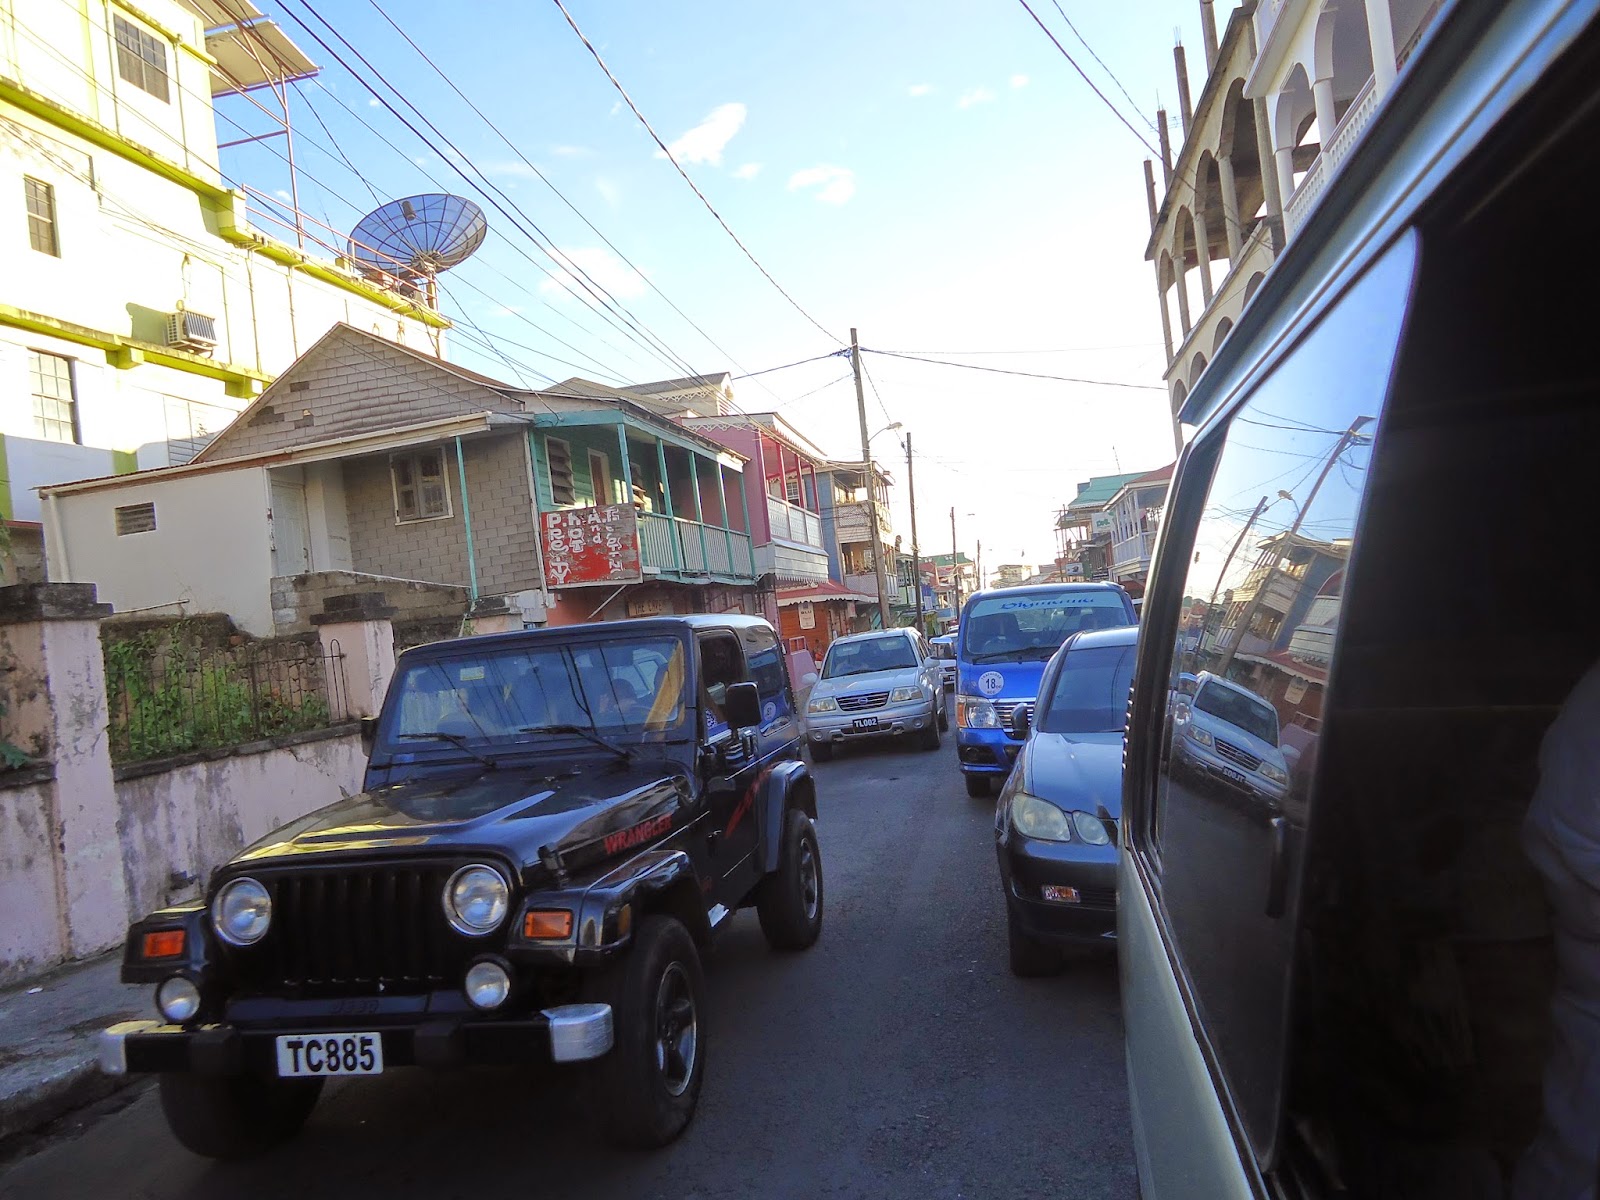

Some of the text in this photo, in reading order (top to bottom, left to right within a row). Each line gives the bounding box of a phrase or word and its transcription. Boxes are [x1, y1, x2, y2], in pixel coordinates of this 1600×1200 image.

[985, 678, 996, 689] 18
[853, 718, 878, 728] TL002
[286, 1037, 375, 1073] TC885
